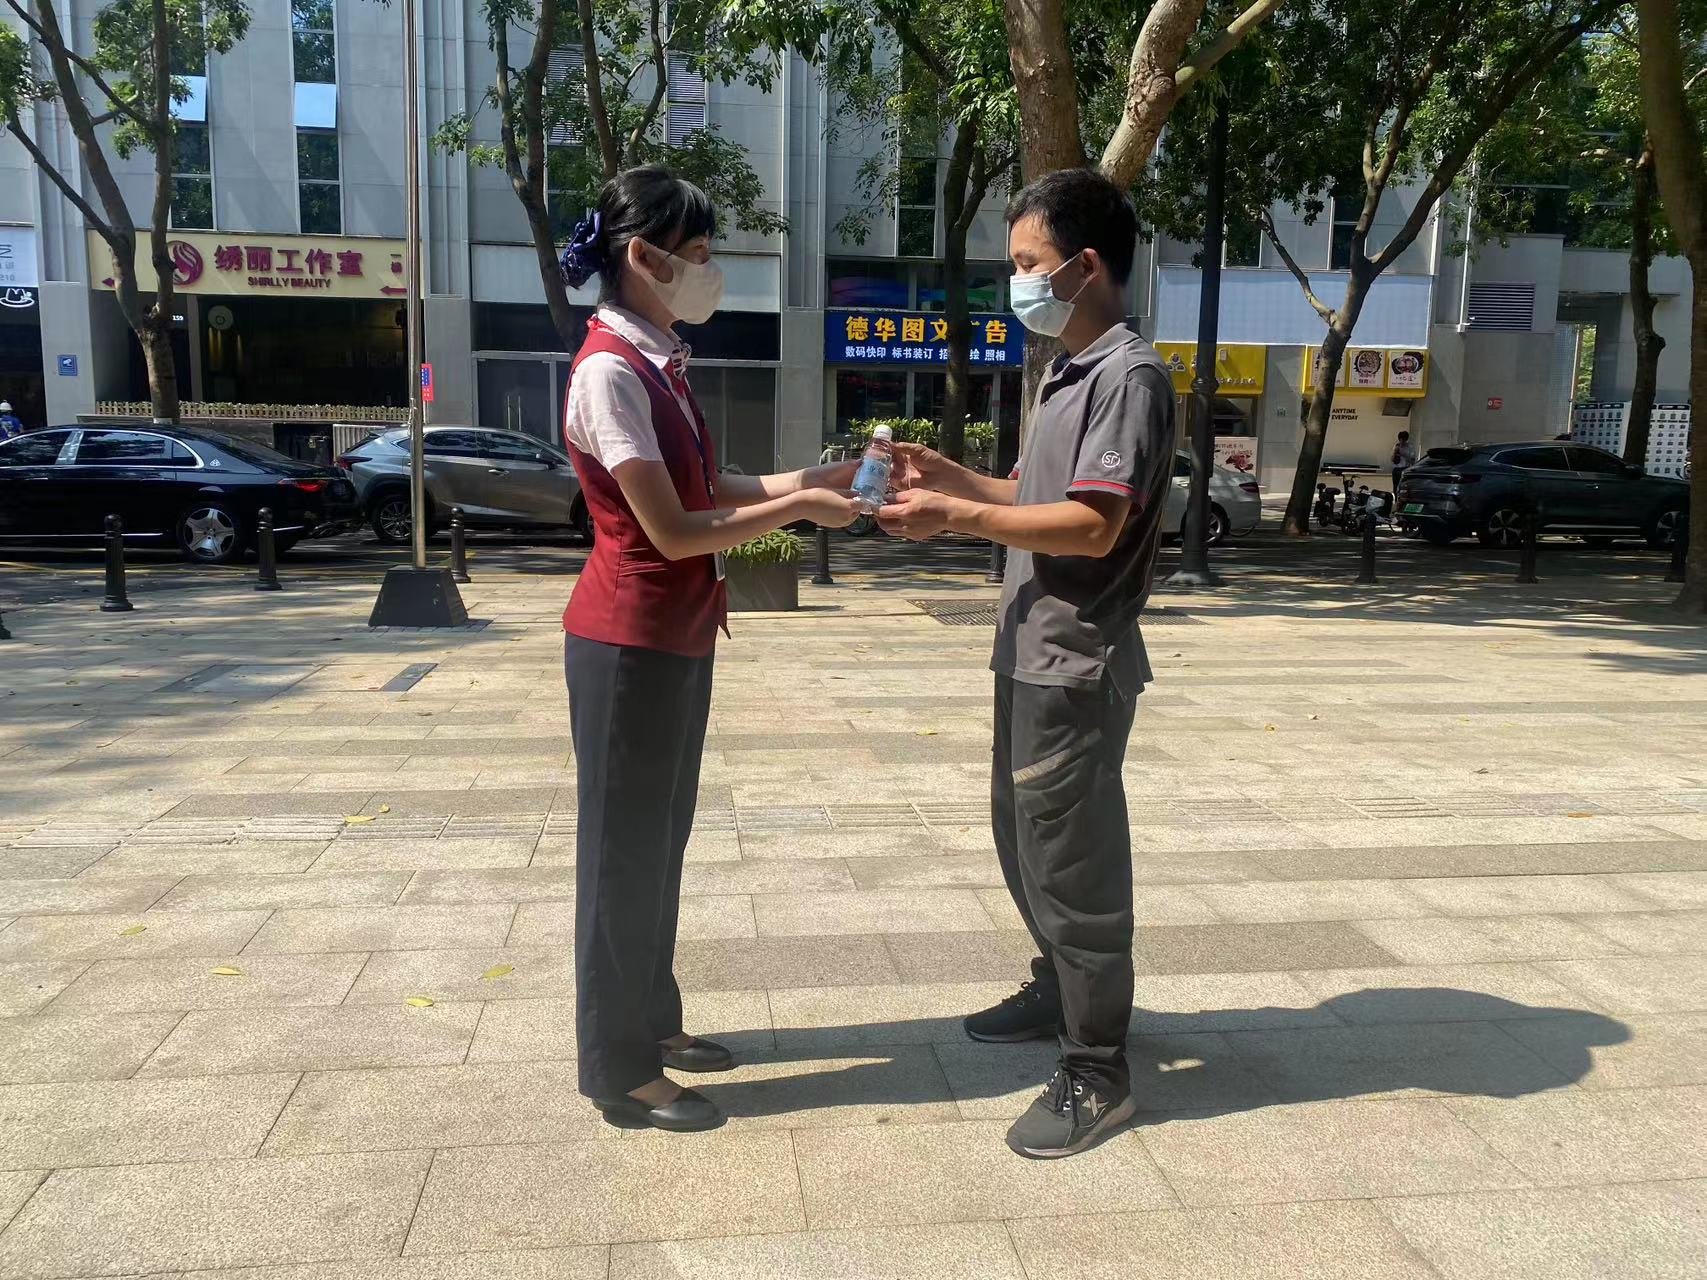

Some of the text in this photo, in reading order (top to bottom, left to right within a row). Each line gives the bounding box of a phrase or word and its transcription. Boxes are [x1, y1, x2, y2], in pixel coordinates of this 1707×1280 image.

[213, 244, 364, 277] 绣丽工作室
[247, 276, 331, 288] SHIRLLY BEAUTY
[845, 315, 1008, 344] 德华图文告
[845, 346, 886, 358] 数码快印
[892, 347, 934, 360] 标书装订
[984, 349, 1006, 362] 照相
